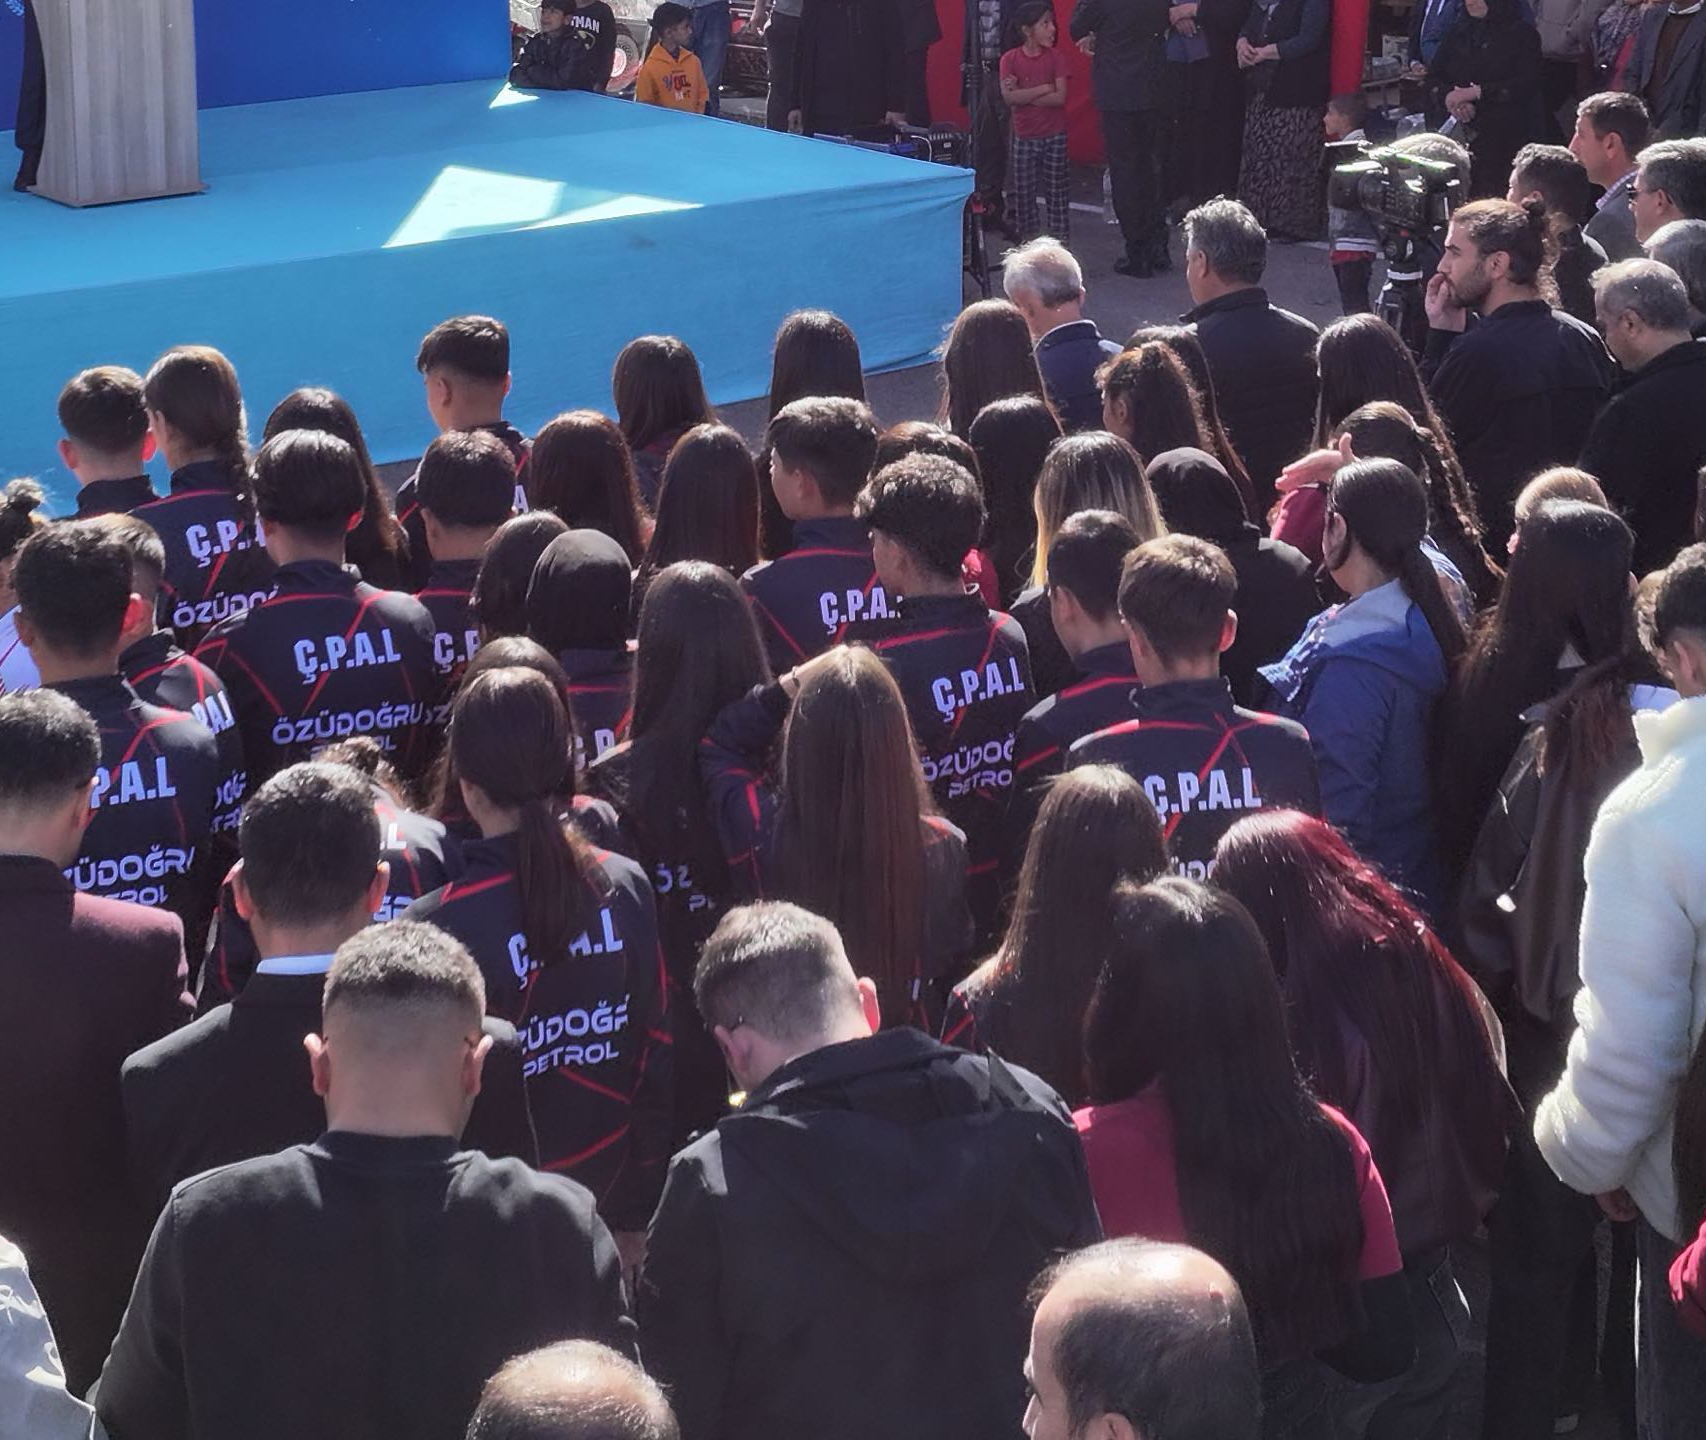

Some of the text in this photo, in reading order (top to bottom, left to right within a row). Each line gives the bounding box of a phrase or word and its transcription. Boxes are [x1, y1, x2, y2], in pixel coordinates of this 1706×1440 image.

[820, 587, 902, 634] Ç.P.A.
[293, 628, 401, 685] Ç.P.A.L
[932, 656, 1026, 723] Ç.P.A.L
[90, 756, 176, 810] P.A.L
[948, 768, 1013, 799] PETRO
[523, 1039, 620, 1079] PETROL
